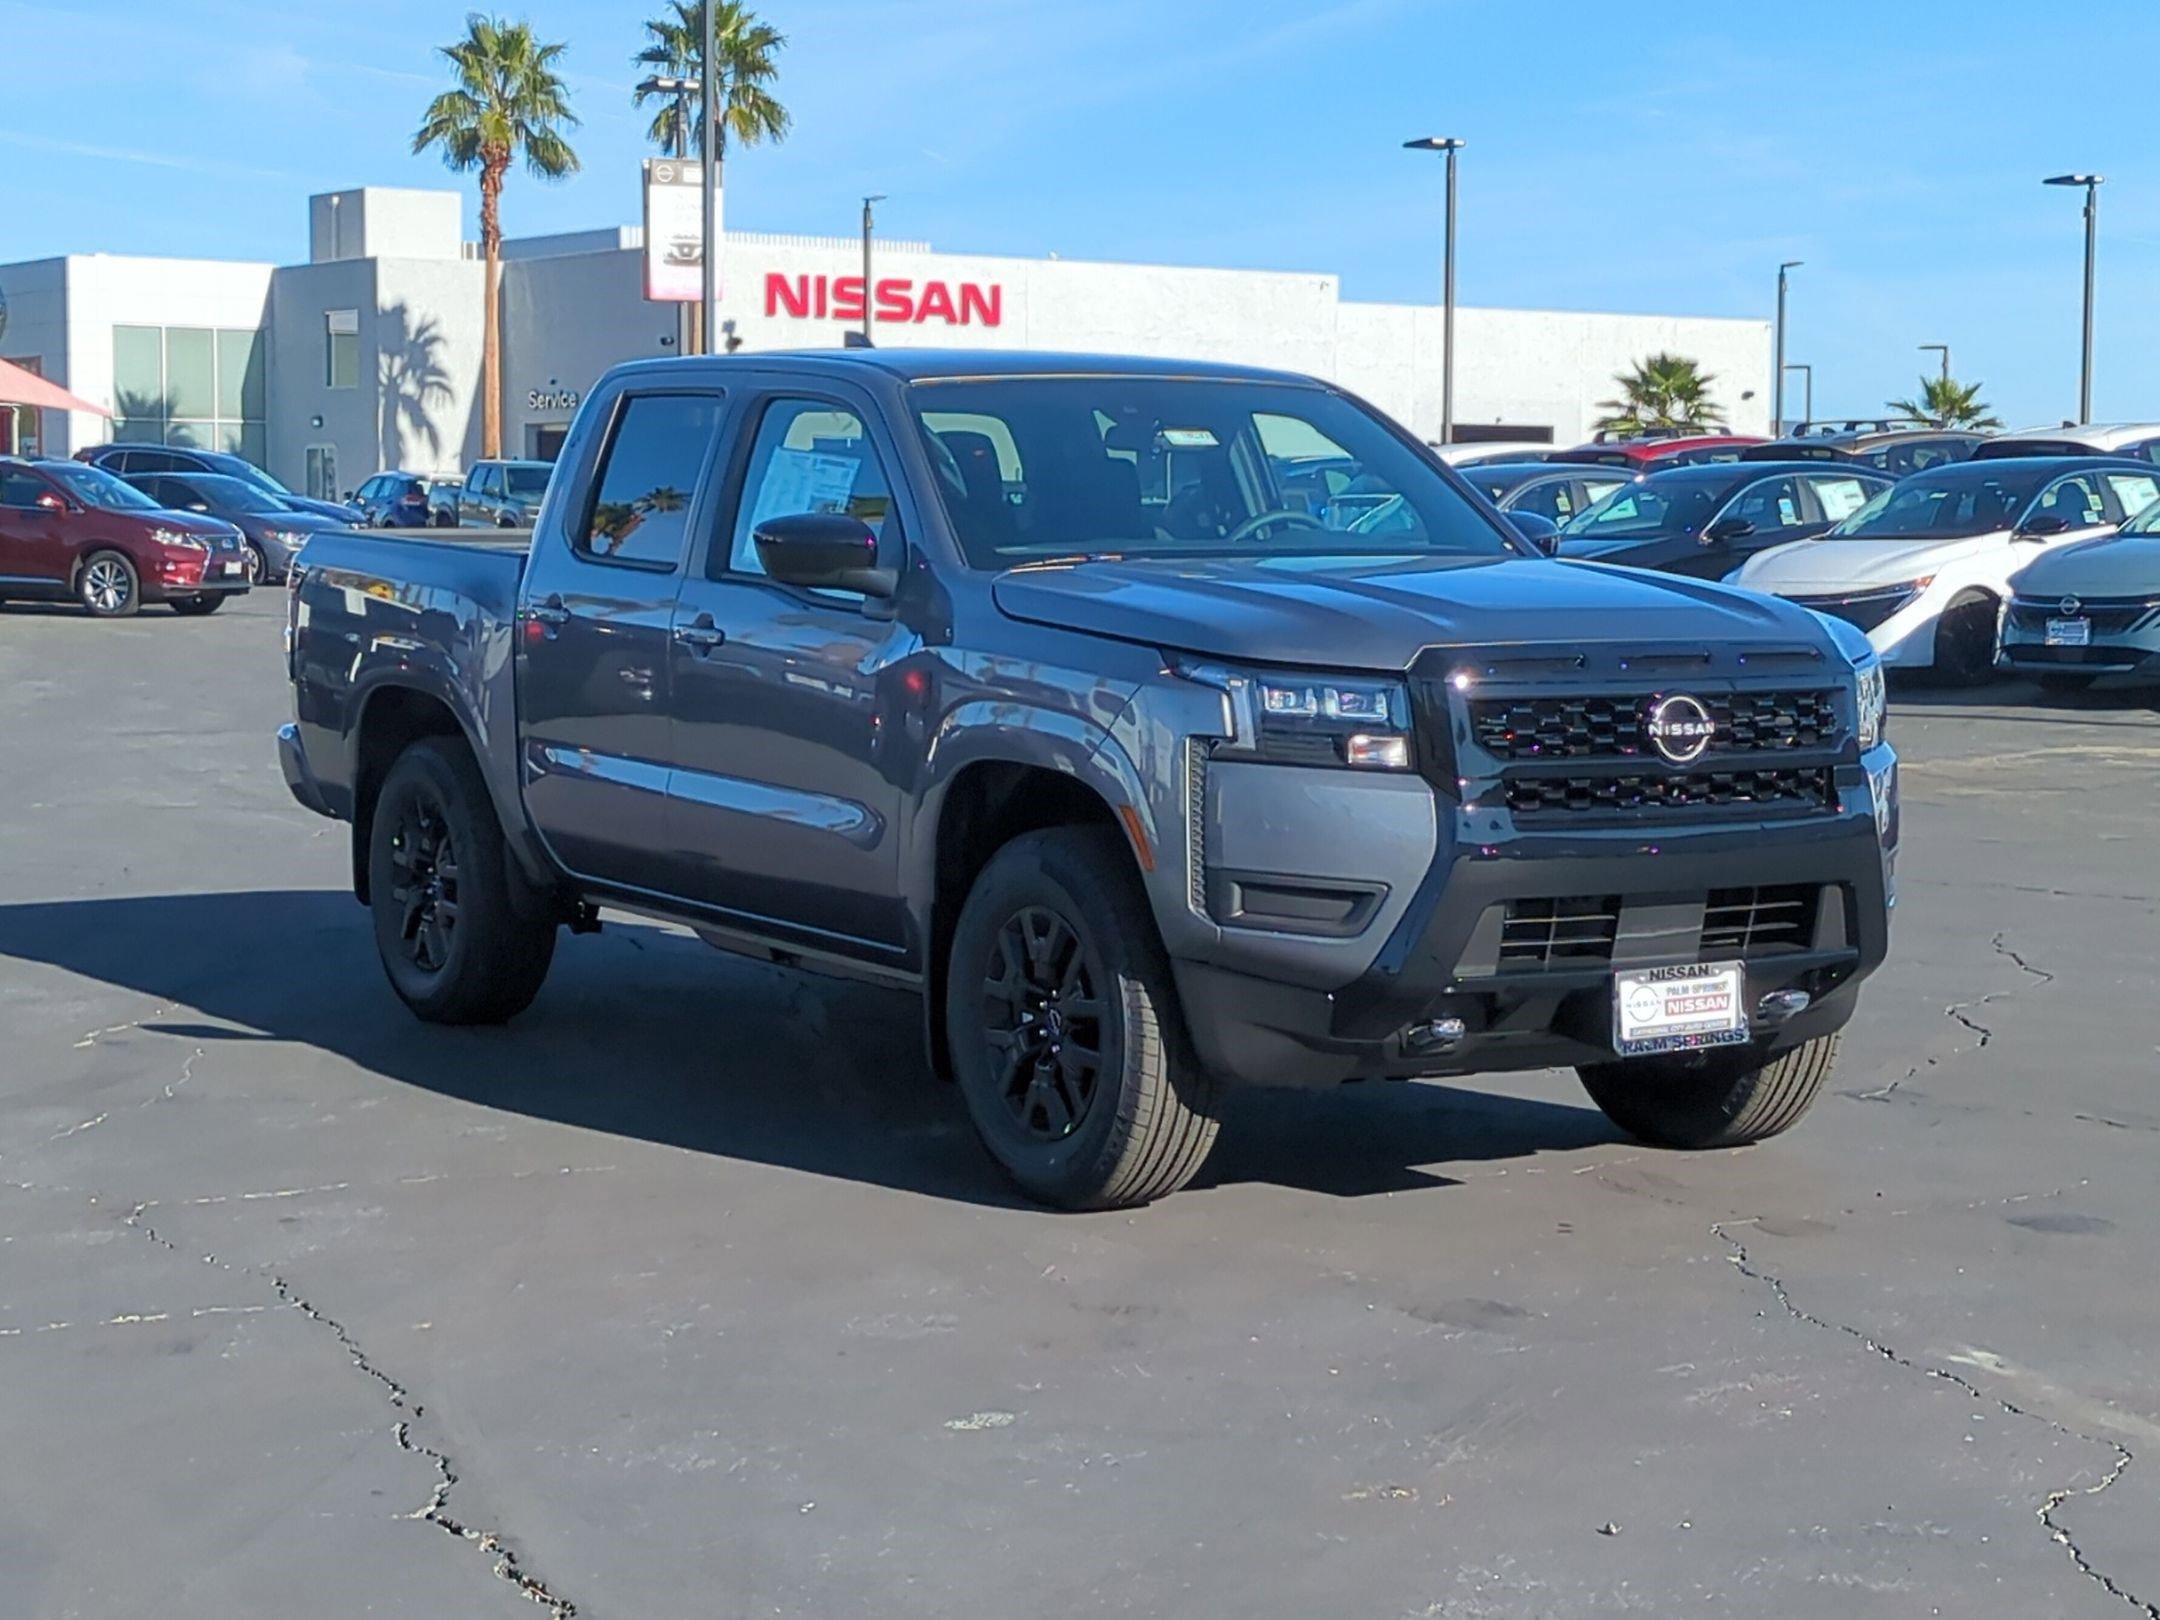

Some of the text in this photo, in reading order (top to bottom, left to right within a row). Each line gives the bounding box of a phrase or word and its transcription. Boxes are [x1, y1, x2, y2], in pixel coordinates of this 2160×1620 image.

[765, 273, 1001, 327] NISSAN
[528, 390, 577, 409] Service
[1648, 722, 1715, 736] NISSAN
[1649, 965, 1709, 981] NISSAN
[1666, 986, 1690, 996] PALM
[1668, 996, 1728, 1014] NISSAN
